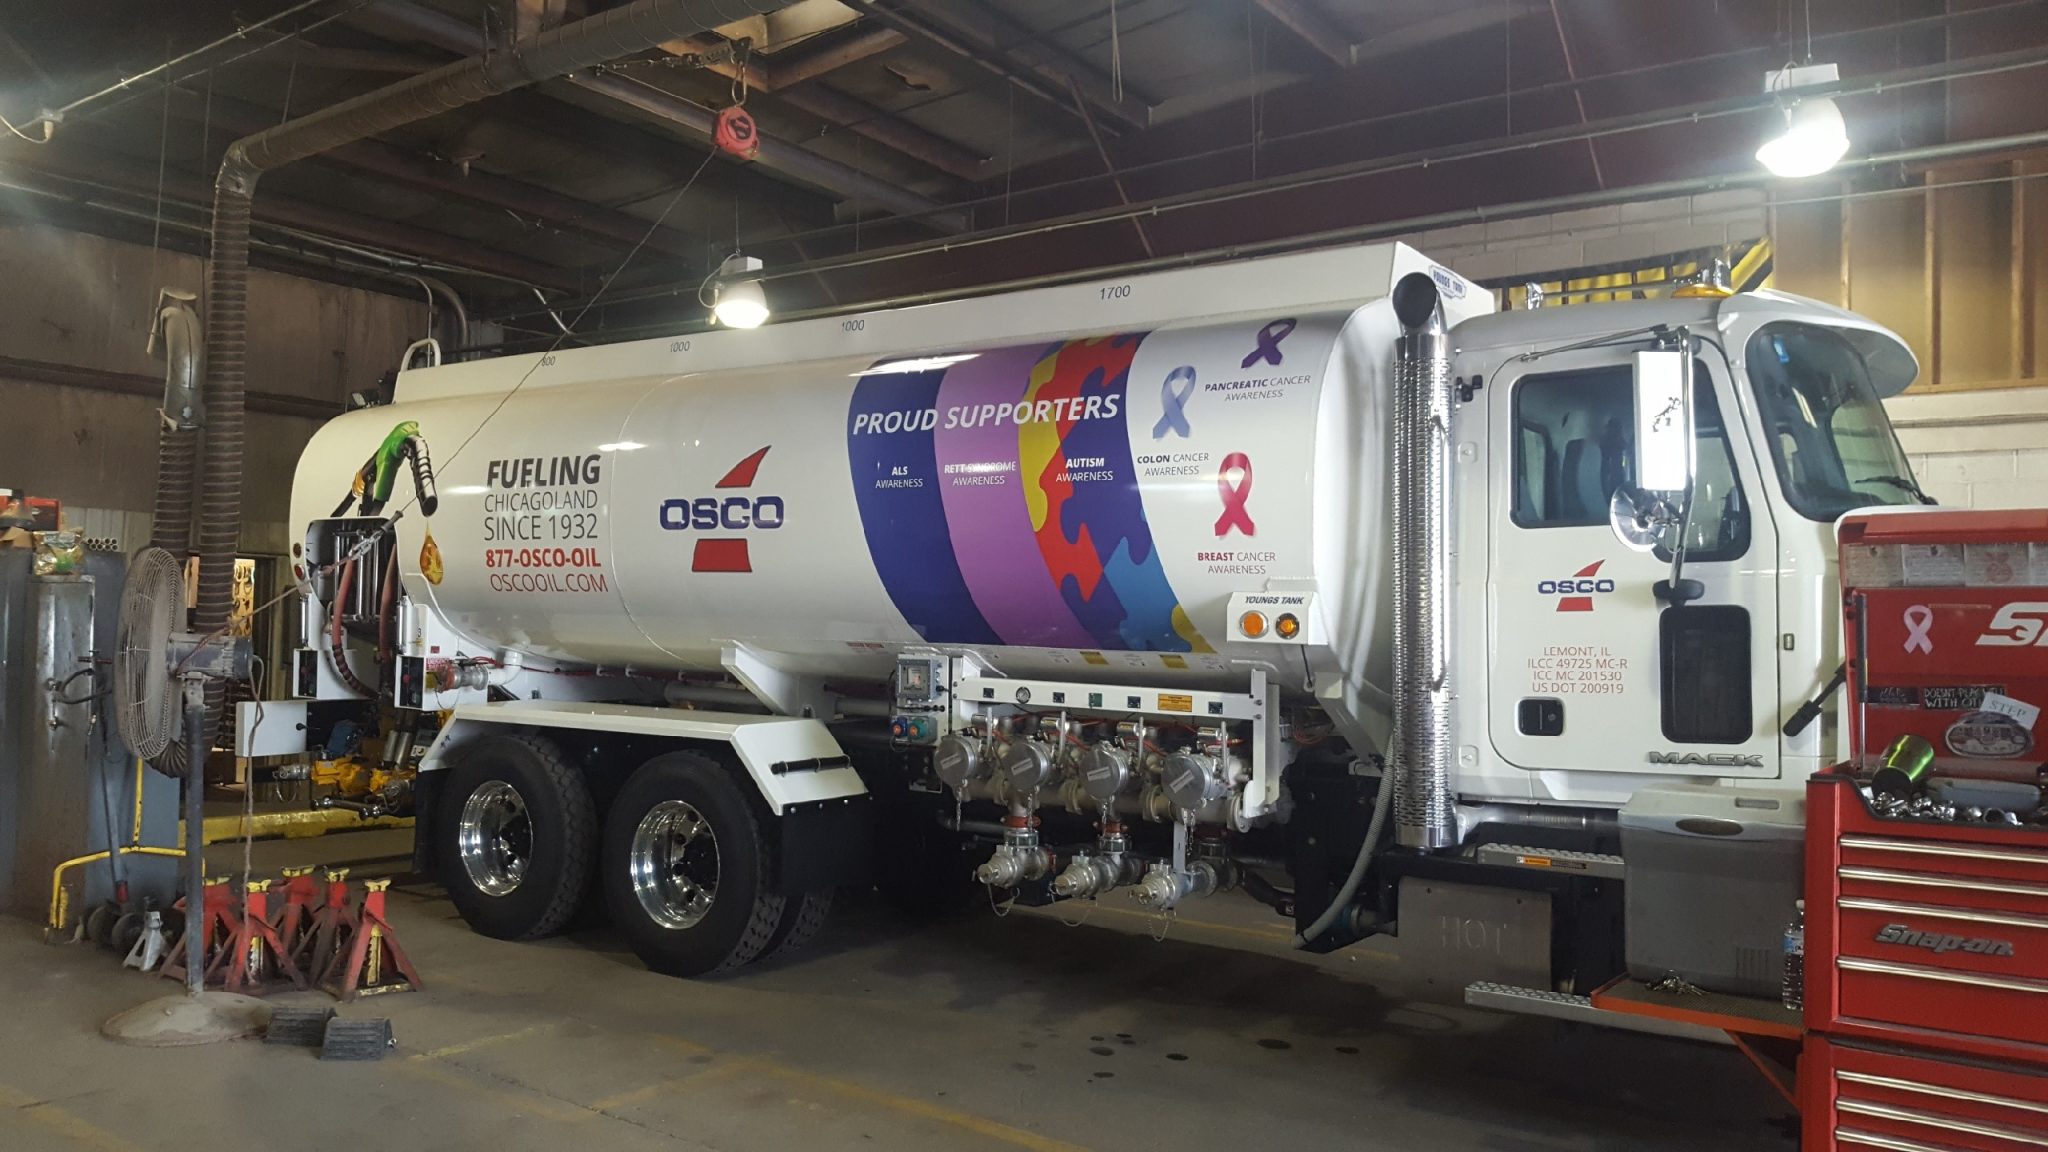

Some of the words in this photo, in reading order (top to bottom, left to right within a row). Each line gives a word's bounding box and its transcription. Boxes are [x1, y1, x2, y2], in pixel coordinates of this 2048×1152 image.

[1099, 284, 1131, 300] 1700
[841, 318, 866, 333] 1000
[669, 340, 691, 354] 1000
[1204, 378, 1269, 393] PANCREATIC
[1269, 374, 1312, 387] CANCER
[1223, 389, 1284, 402] AWARENESS
[852, 408, 939, 435] PROUD
[943, 393, 1121, 430] SUPPORTERS
[1065, 457, 1105, 469] AUTISM
[1137, 453, 1170, 464] COLON
[1172, 452, 1209, 463] CANCER
[486, 454, 602, 489] FUELING
[891, 466, 908, 476] ALS
[943, 463, 966, 475] RETT
[1144, 465, 1200, 477] AWARENESS
[875, 477, 924, 489] AWARENESS
[952, 475, 1006, 487] AWARENESS
[1055, 470, 1114, 483] AWARENESS
[484, 489, 598, 513] CHICAGOLAND
[659, 496, 784, 530] OSCO
[484, 515, 542, 541] SINCE
[548, 513, 598, 540] 1932
[485, 547, 602, 568] 877-OSCO-OIL
[1197, 551, 1234, 562] BREAST
[1237, 551, 1276, 562] CANCER
[1207, 564, 1267, 575] AWARENESS
[489, 573, 609, 593] OSCOOIL.COM
[1538, 579, 1615, 594] OSCO
[1245, 596, 1280, 604] YOUNGS
[1281, 596, 1305, 605] TANK
[1543, 646, 1597, 657] LEMONT,
[1600, 646, 1612, 656] IL
[1527, 658, 1554, 669] ILCC
[1556, 658, 1592, 669] 49725
[1595, 658, 1628, 669] MC-R
[1533, 670, 1552, 681] ICC
[1556, 670, 1575, 681] MC
[1578, 671, 1622, 681] 201530
[1532, 682, 1548, 693] US
[1551, 682, 1577, 693] DOT
[1580, 683, 1624, 694] 200919
[1925, 698, 1958, 708] WITH
[1648, 751, 1765, 768] MACK
[1875, 923, 2014, 956] Snap-on
